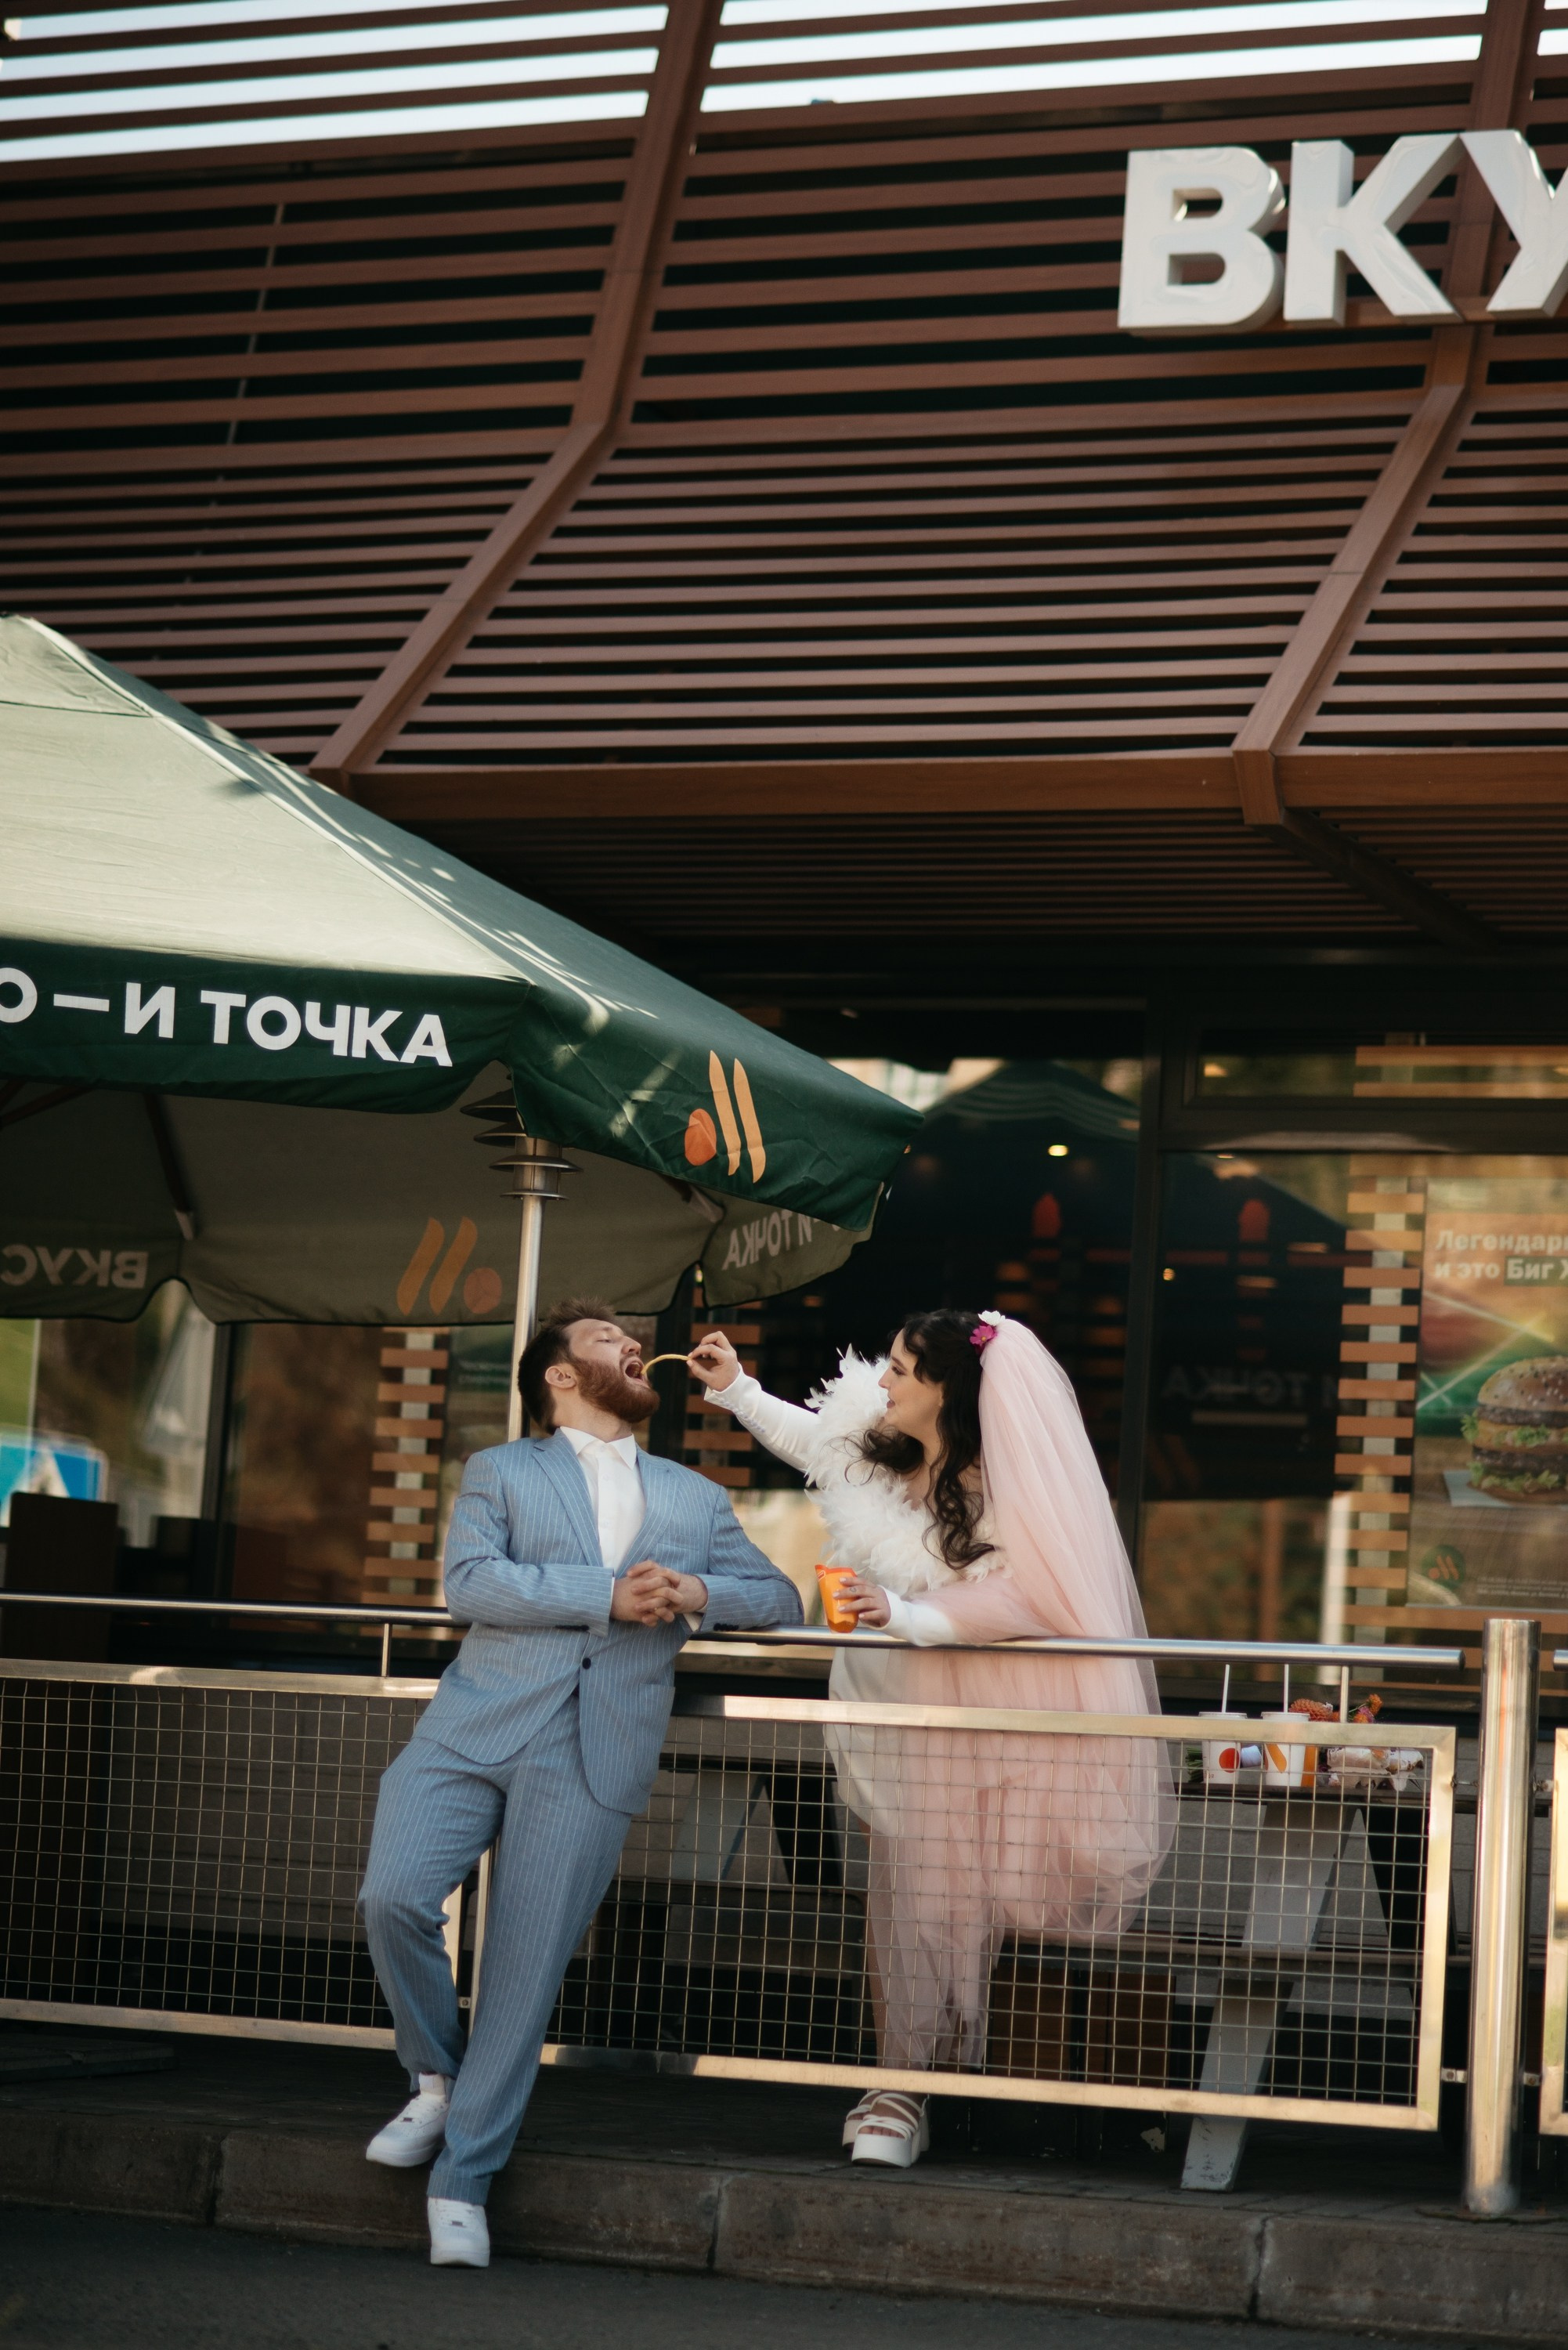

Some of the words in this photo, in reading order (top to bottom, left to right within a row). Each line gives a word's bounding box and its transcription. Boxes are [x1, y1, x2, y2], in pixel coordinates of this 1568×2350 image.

[1118, 128, 1568, 334] ВКУ
[124, 982, 175, 1039] И
[200, 989, 453, 1068] ТОЧКА
[1434, 1262, 1451, 1278] и
[1457, 1262, 1501, 1279] это
[1506, 1257, 1555, 1280] Биг
[1436, 1230, 1568, 1255] Легендар
